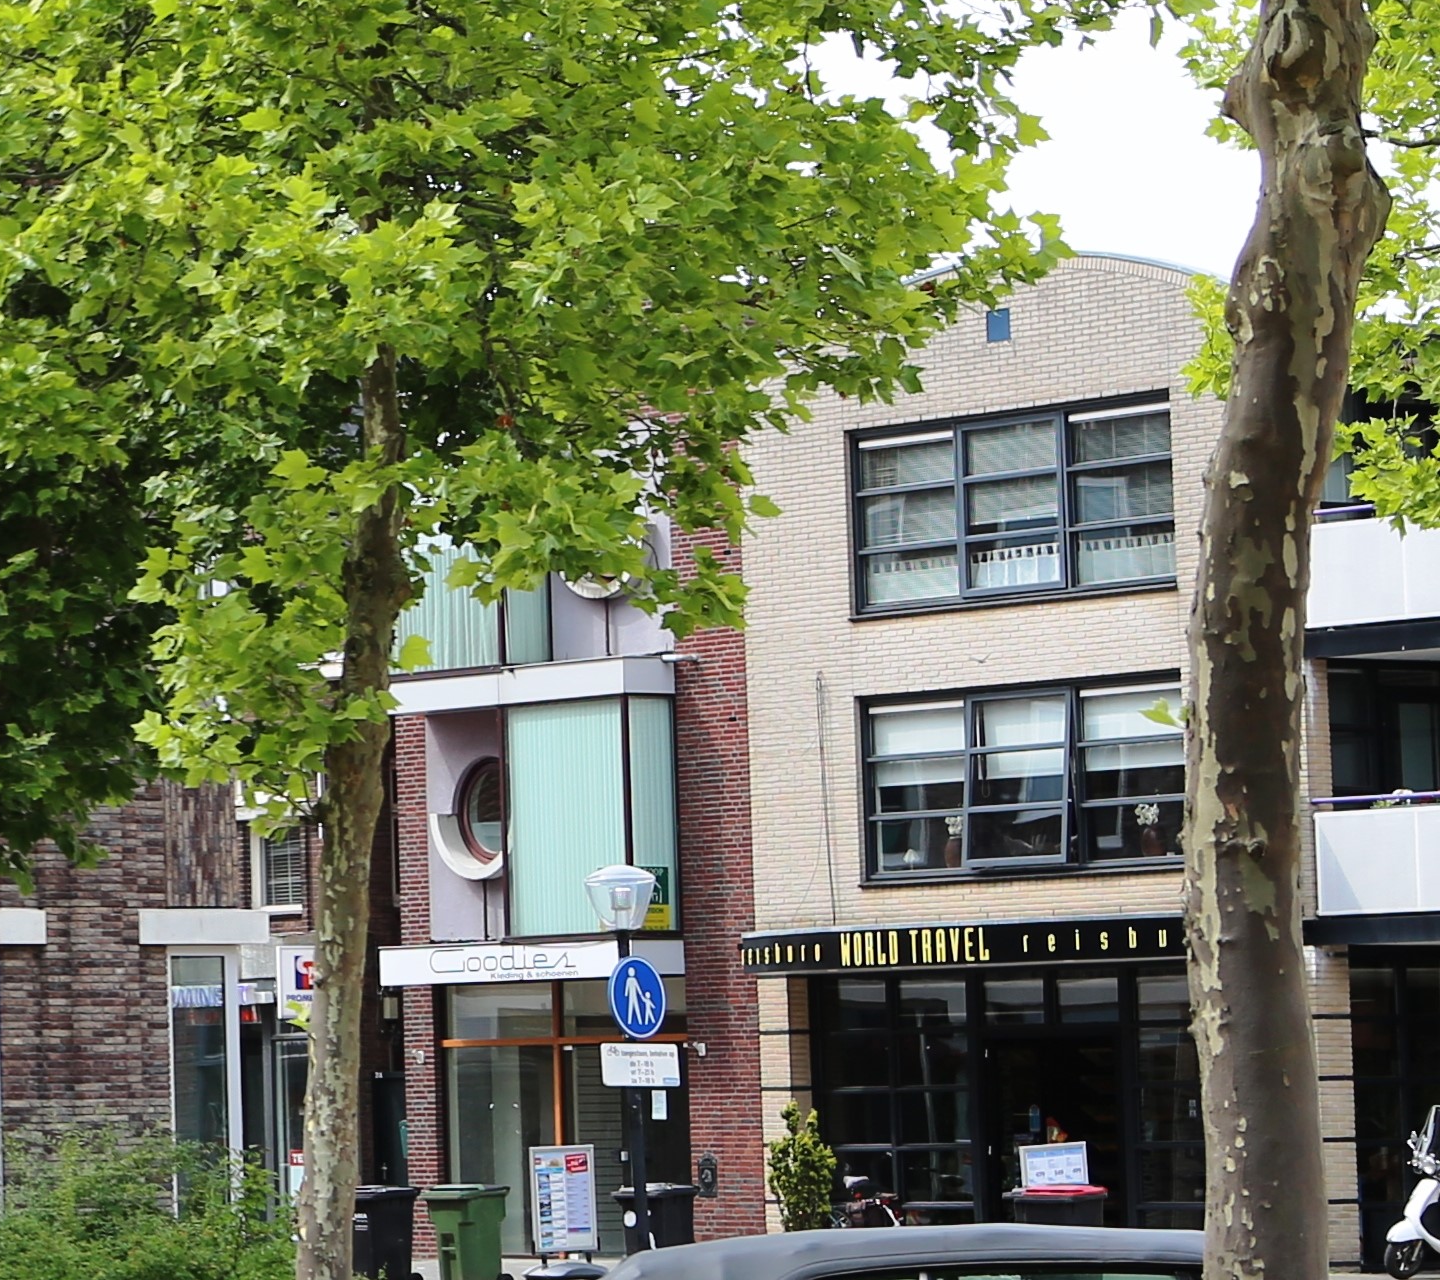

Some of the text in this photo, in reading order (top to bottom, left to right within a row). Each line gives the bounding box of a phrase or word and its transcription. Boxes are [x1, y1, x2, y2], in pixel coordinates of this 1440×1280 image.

[840, 930, 899, 967] WORLD
[908, 927, 991, 964] TRAVEL
[1022, 926, 1168, 953] reisbu
[430, 946, 577, 974] Goodies
[490, 972, 524, 980] Kleding
[535, 970, 579, 978] schoenen
